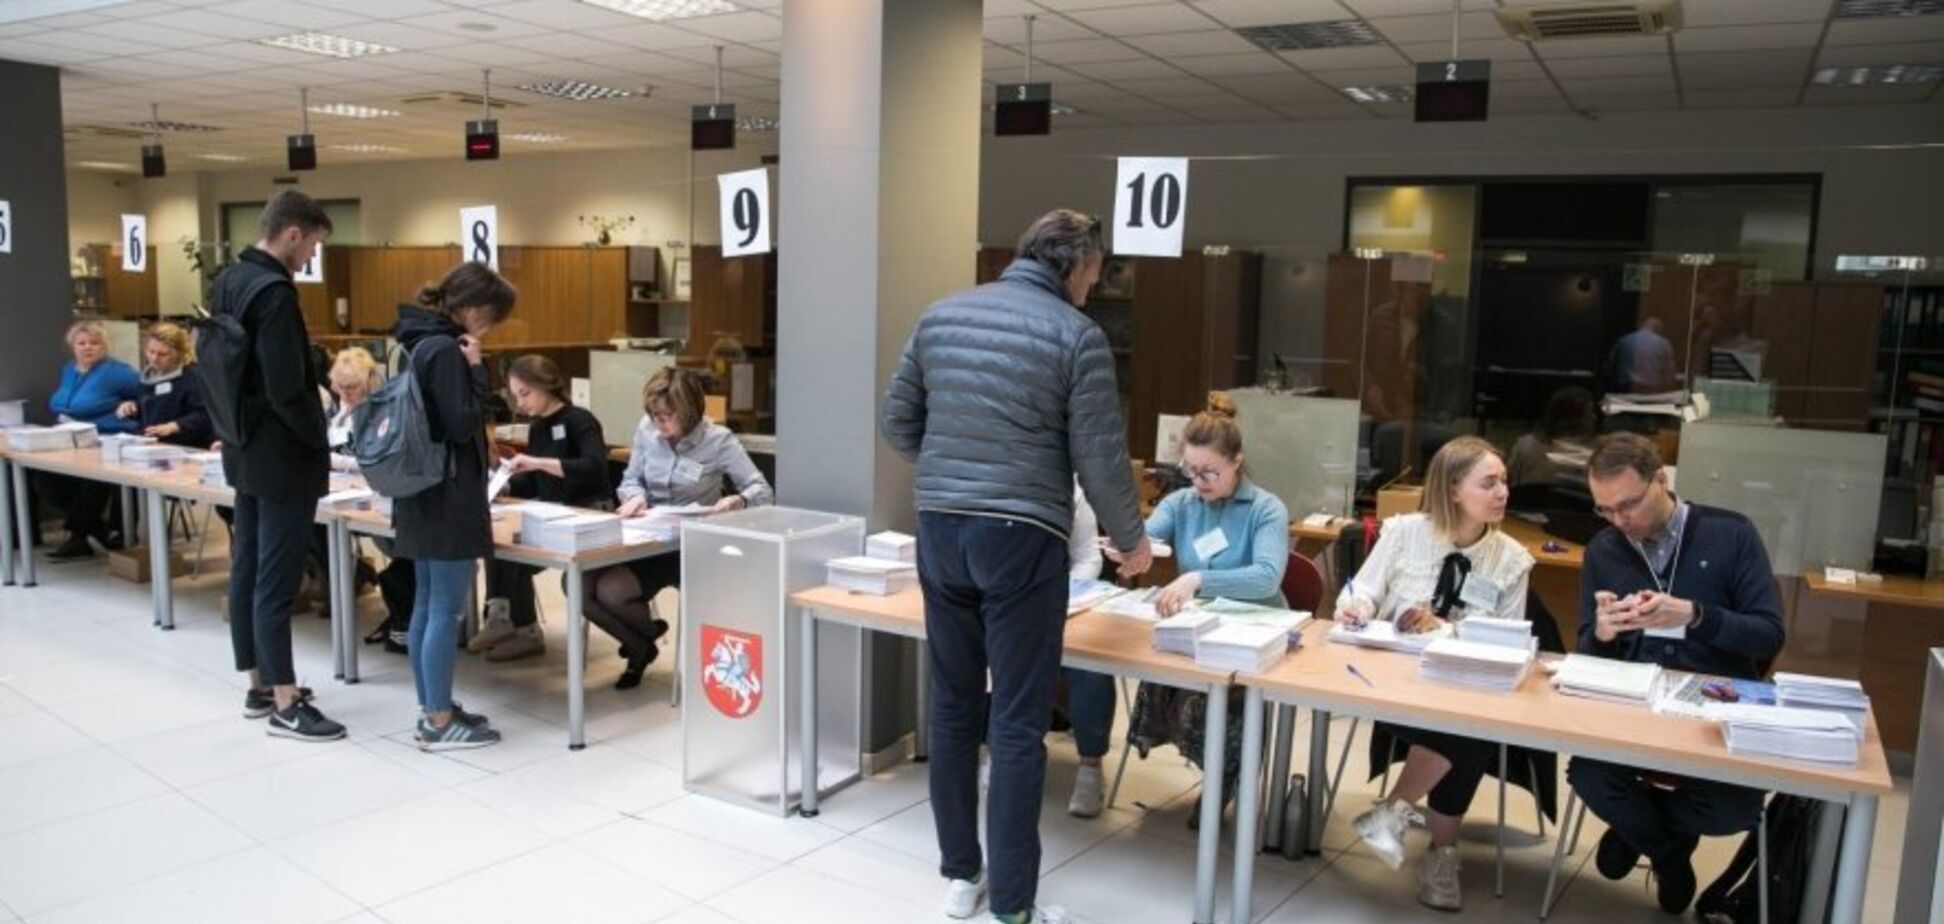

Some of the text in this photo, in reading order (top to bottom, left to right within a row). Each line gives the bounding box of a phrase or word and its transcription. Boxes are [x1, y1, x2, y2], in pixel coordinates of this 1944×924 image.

[1017, 85, 1026, 101] 3
[1446, 63, 1456, 81] 2
[733, 187, 760, 248] 9
[1126, 172, 1180, 229] 10
[130, 225, 142, 266] 6
[472, 219, 492, 264] 8
